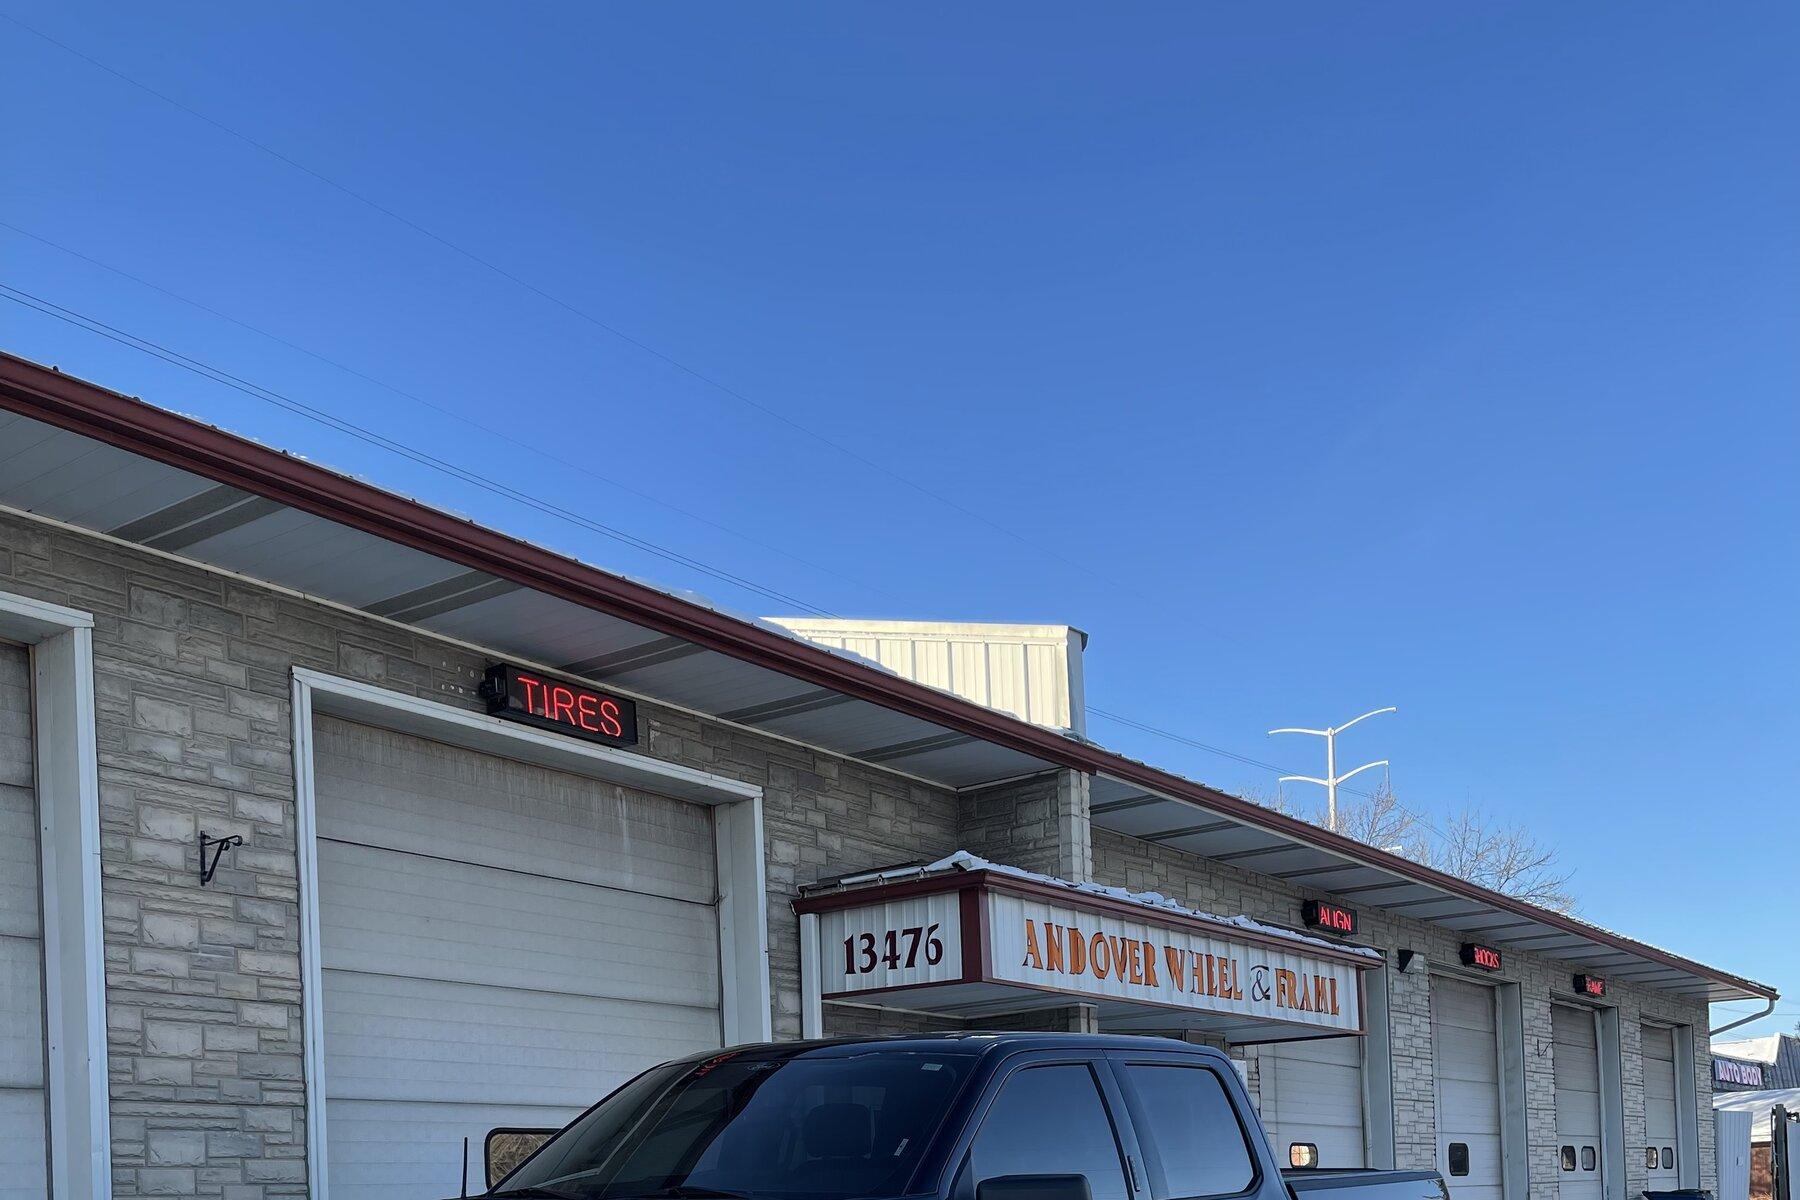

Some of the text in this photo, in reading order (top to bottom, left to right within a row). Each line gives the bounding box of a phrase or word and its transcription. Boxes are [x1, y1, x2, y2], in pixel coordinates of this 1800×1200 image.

[517, 675, 622, 737] TIRES
[843, 922, 944, 975] 13476
[1022, 918, 1340, 1016] ANDOVER WHEEL & FRAME
[1718, 1060, 1763, 1086] AUTO BODY
